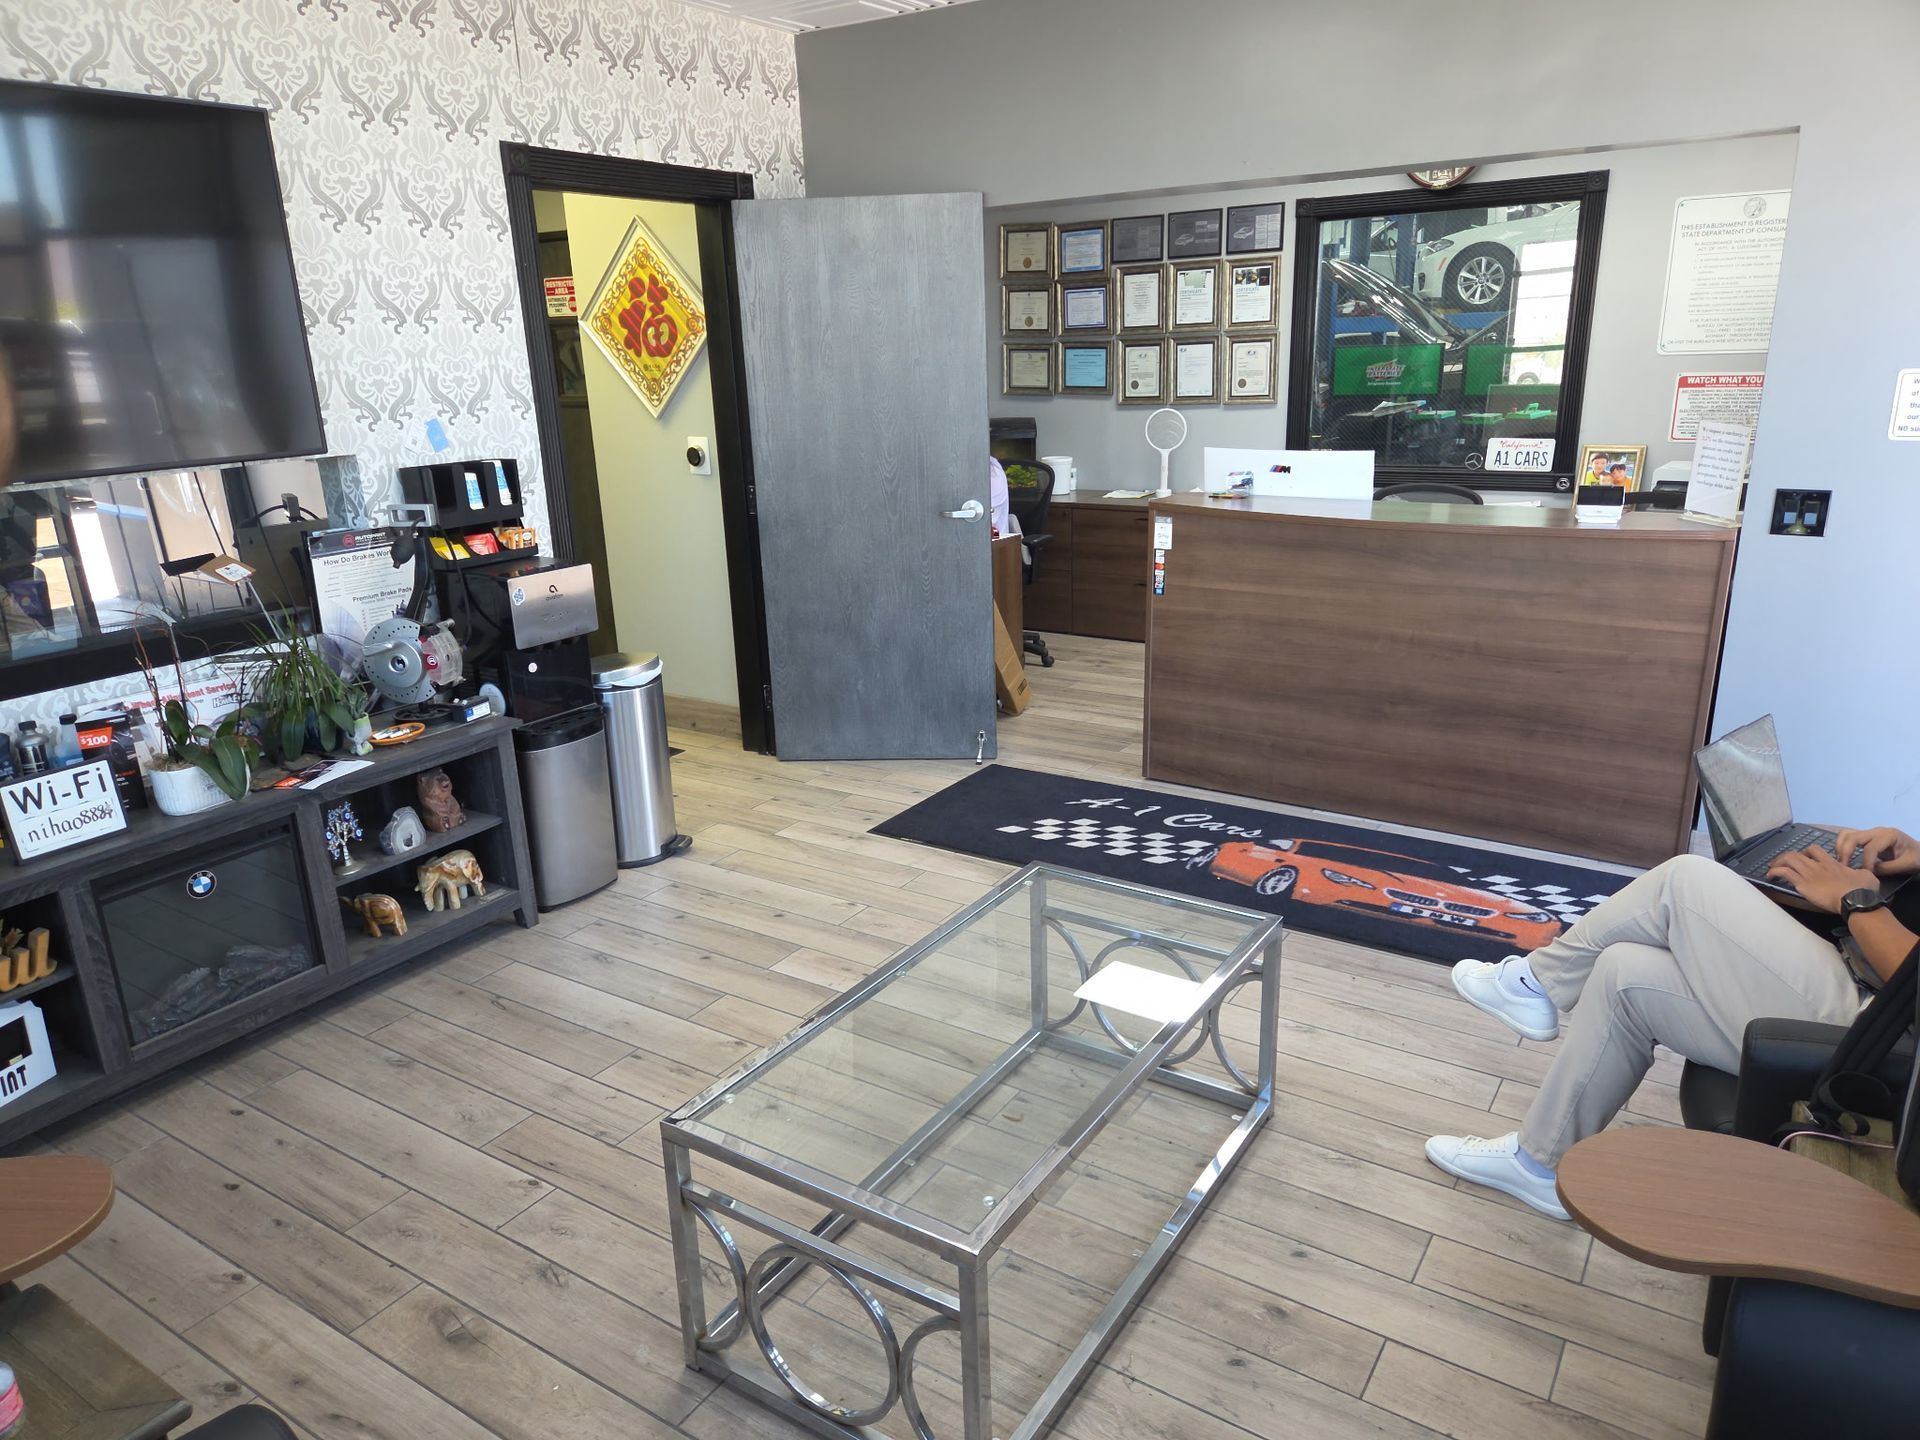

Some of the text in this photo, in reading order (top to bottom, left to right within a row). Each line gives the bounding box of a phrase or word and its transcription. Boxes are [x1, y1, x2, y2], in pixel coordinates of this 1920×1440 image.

[1695, 220, 1747, 230] ESTABLISHMENT
[1701, 229, 1744, 237] DEPARTMENT
[545, 280, 574, 288] RESTRICTE
[618, 273, 678, 358] 福
[1687, 375, 1763, 384] WATCH WHAT YOU
[1501, 441, 1543, 450] California
[1494, 450, 1548, 467] A1 CARS
[323, 558, 340, 567] How
[352, 553, 376, 562] Brakes
[352, 586, 413, 603] Premium Brake Pads
[205, 680, 237, 694] Service
[80, 735, 109, 747] $100
[9, 767, 108, 815] Wi-Fi
[1064, 797, 1263, 838] A-1 Cars
